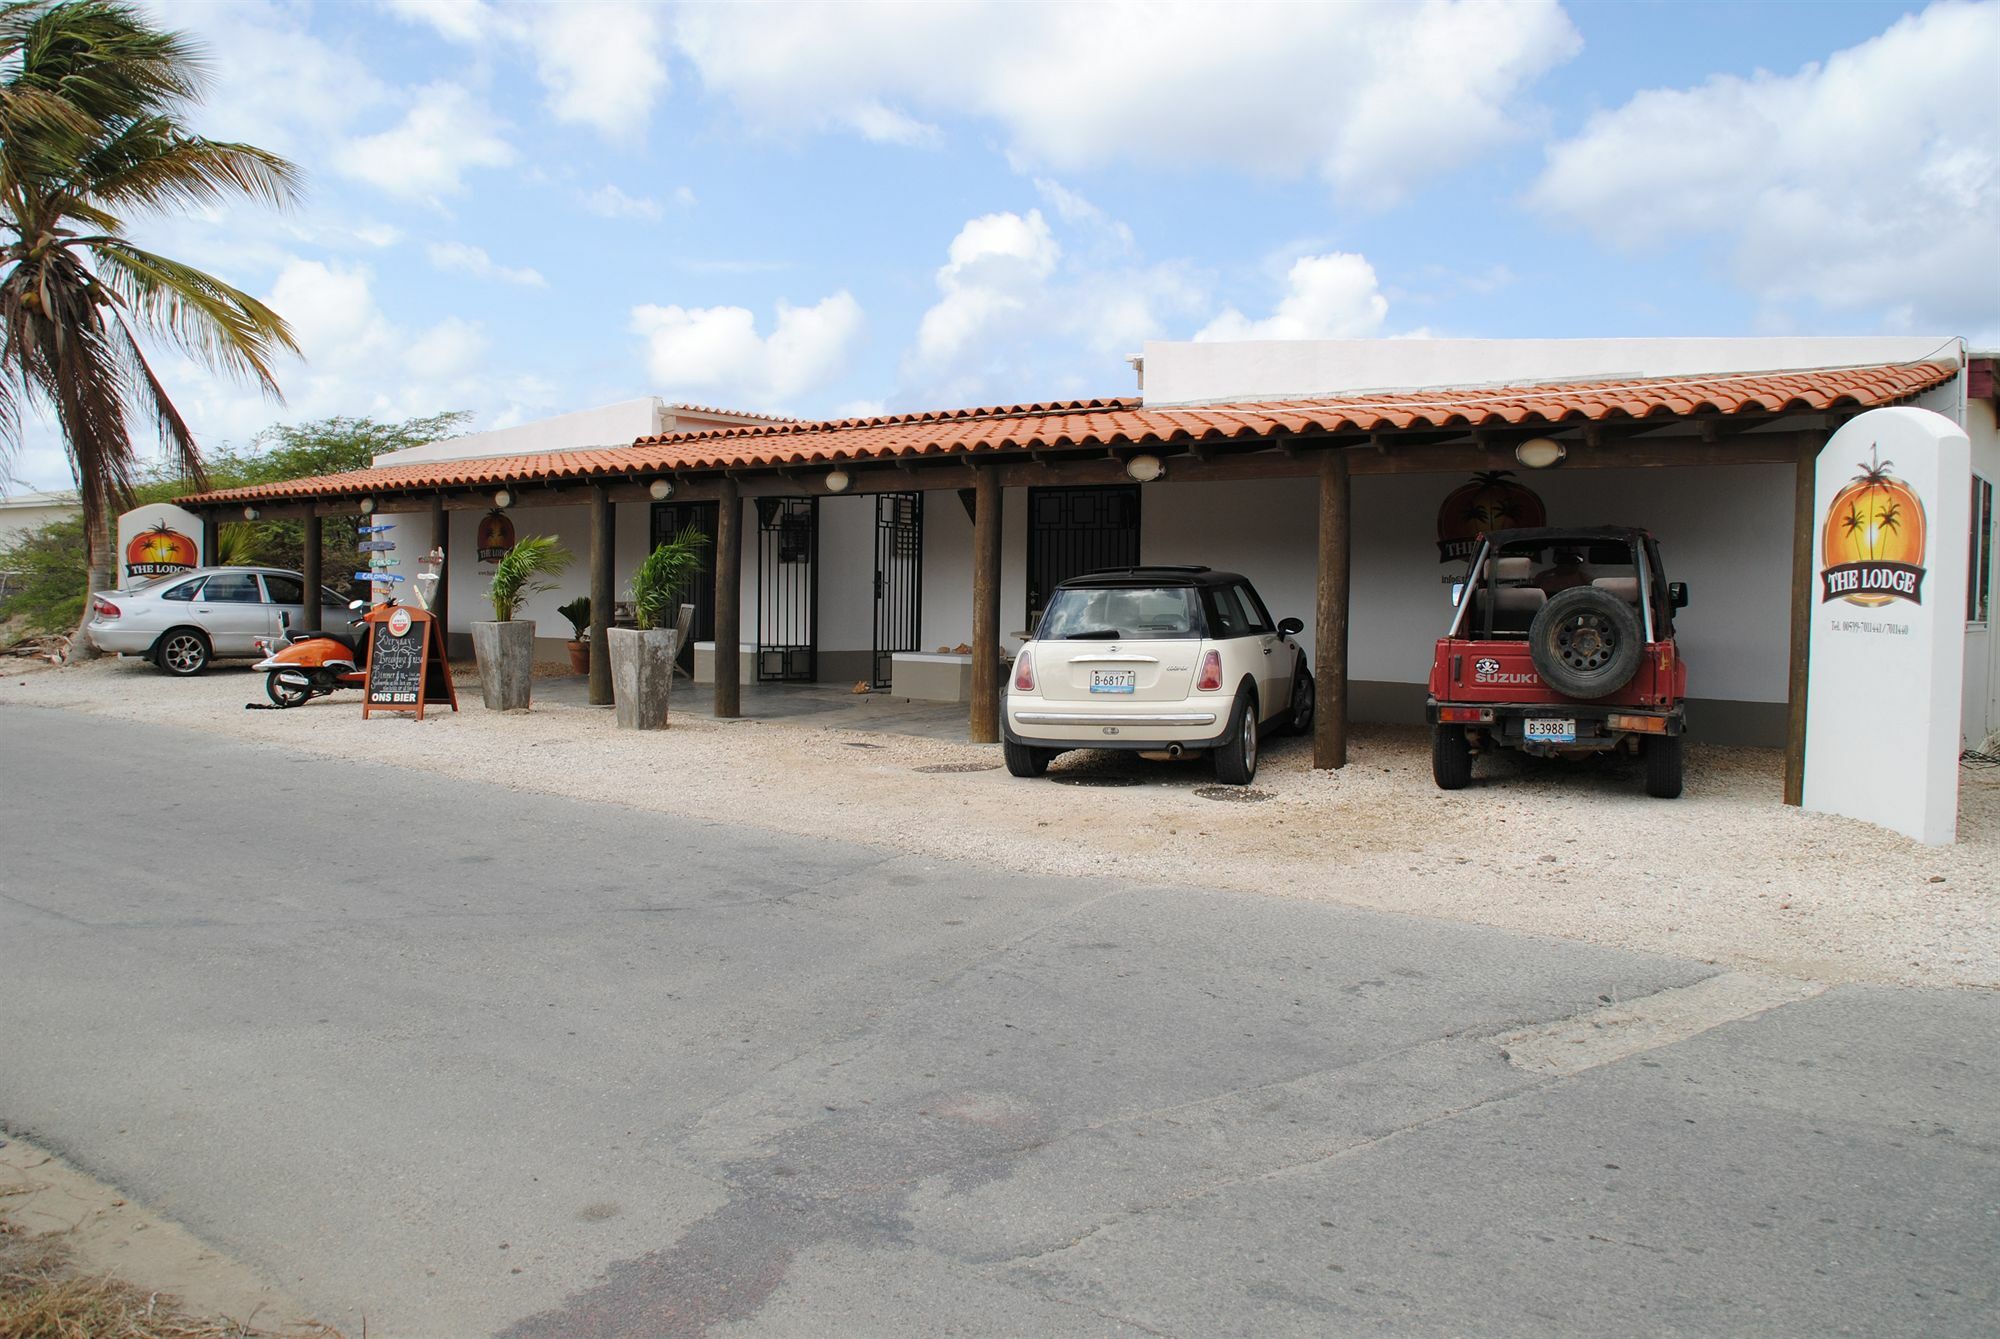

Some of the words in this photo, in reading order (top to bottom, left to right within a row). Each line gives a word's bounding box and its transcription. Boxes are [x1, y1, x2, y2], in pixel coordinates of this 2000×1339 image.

[131, 564, 154, 575] THE
[1828, 569, 1859, 594] THE
[1861, 568, 1917, 594] LODGE
[1094, 675, 1125, 686] B-6817
[1475, 673, 1538, 684] SUZUKI
[371, 692, 392, 702] ONS
[393, 692, 416, 702] BIER
[1529, 723, 1564, 735] B-3988
